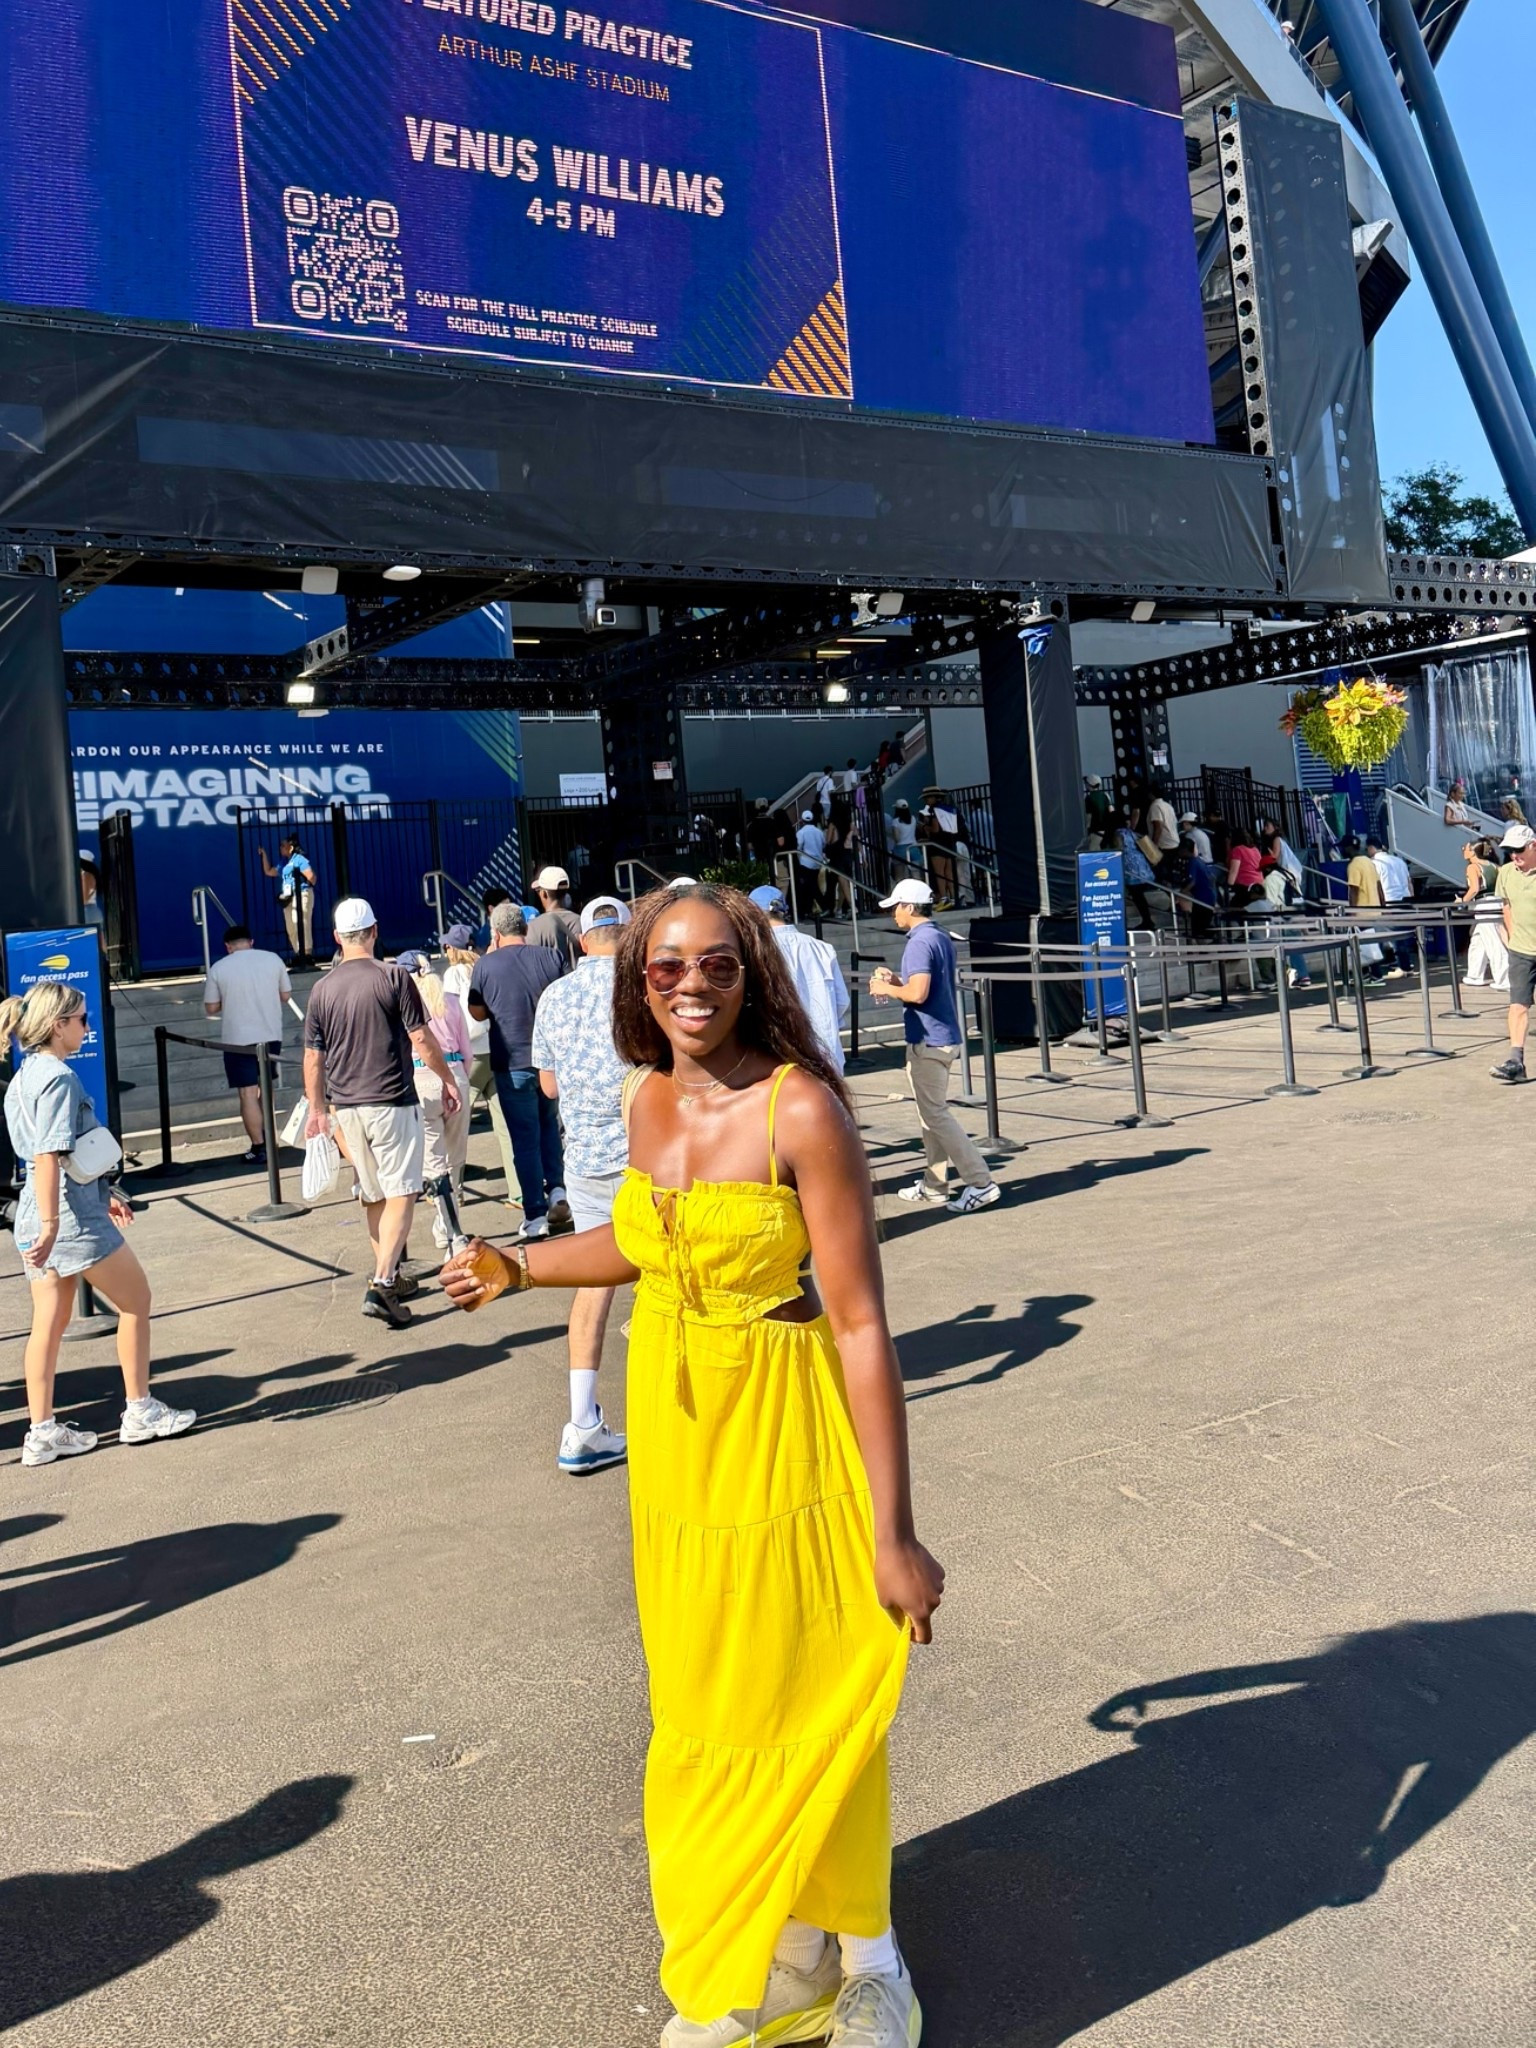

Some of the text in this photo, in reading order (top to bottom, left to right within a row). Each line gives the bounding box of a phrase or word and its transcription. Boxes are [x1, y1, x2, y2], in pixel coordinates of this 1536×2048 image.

[404, 0, 693, 70] TURED PRACTICE
[438, 34, 523, 71] ARTHUR
[586, 67, 670, 102] STADIUM
[405, 116, 725, 217] VENUS WILLIAMS
[526, 197, 616, 239] 4-5 PM
[415, 289, 659, 337] SCAN FOR THE FULL PRACTICE SCHEDULE
[447, 315, 635, 354] SCHEDULE SUBJECT TO CHANGE
[129, 745, 162, 756] OUR
[170, 744, 272, 756] APPEARANCE
[279, 744, 324, 755] WHILE
[331, 744, 350, 754] WE
[357, 743, 384, 754] ARE
[73, 764, 371, 800] IMAGINING
[76, 793, 392, 831] ECTACULAR
[20, 971, 89, 984] fan access pass
